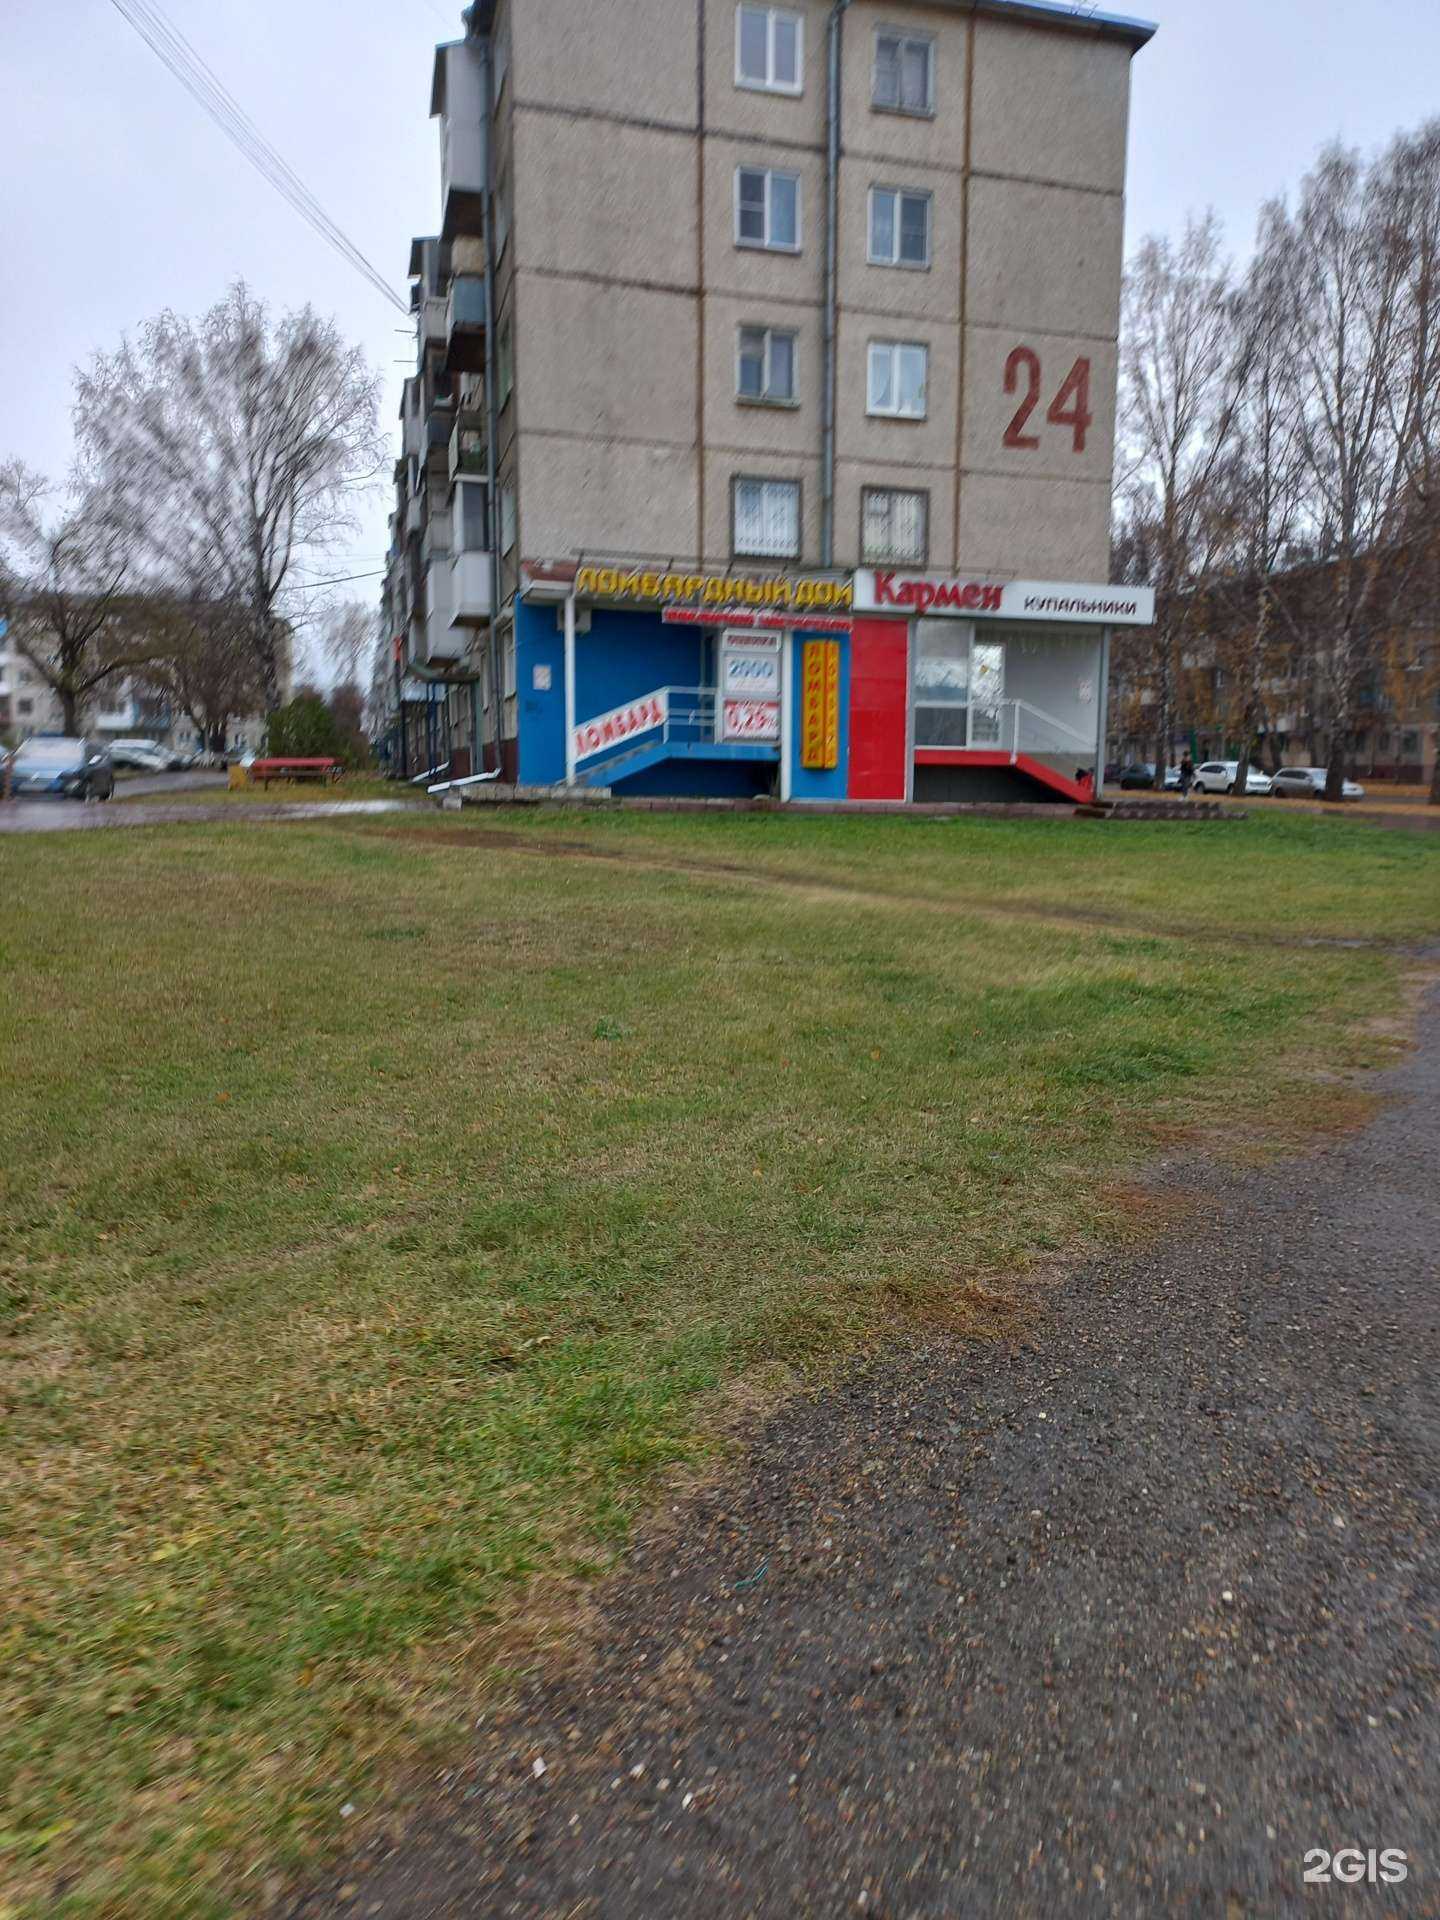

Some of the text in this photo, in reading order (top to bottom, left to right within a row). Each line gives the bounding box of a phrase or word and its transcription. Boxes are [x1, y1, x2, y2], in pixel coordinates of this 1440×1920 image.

[1002, 344, 1094, 454] 24
[795, 578, 853, 607] ДОМ
[873, 569, 1005, 616] Кармен
[1024, 594, 1137, 615] КУПАЛЬНИКИ
[807, 644, 821, 761] ЛОМБАРД
